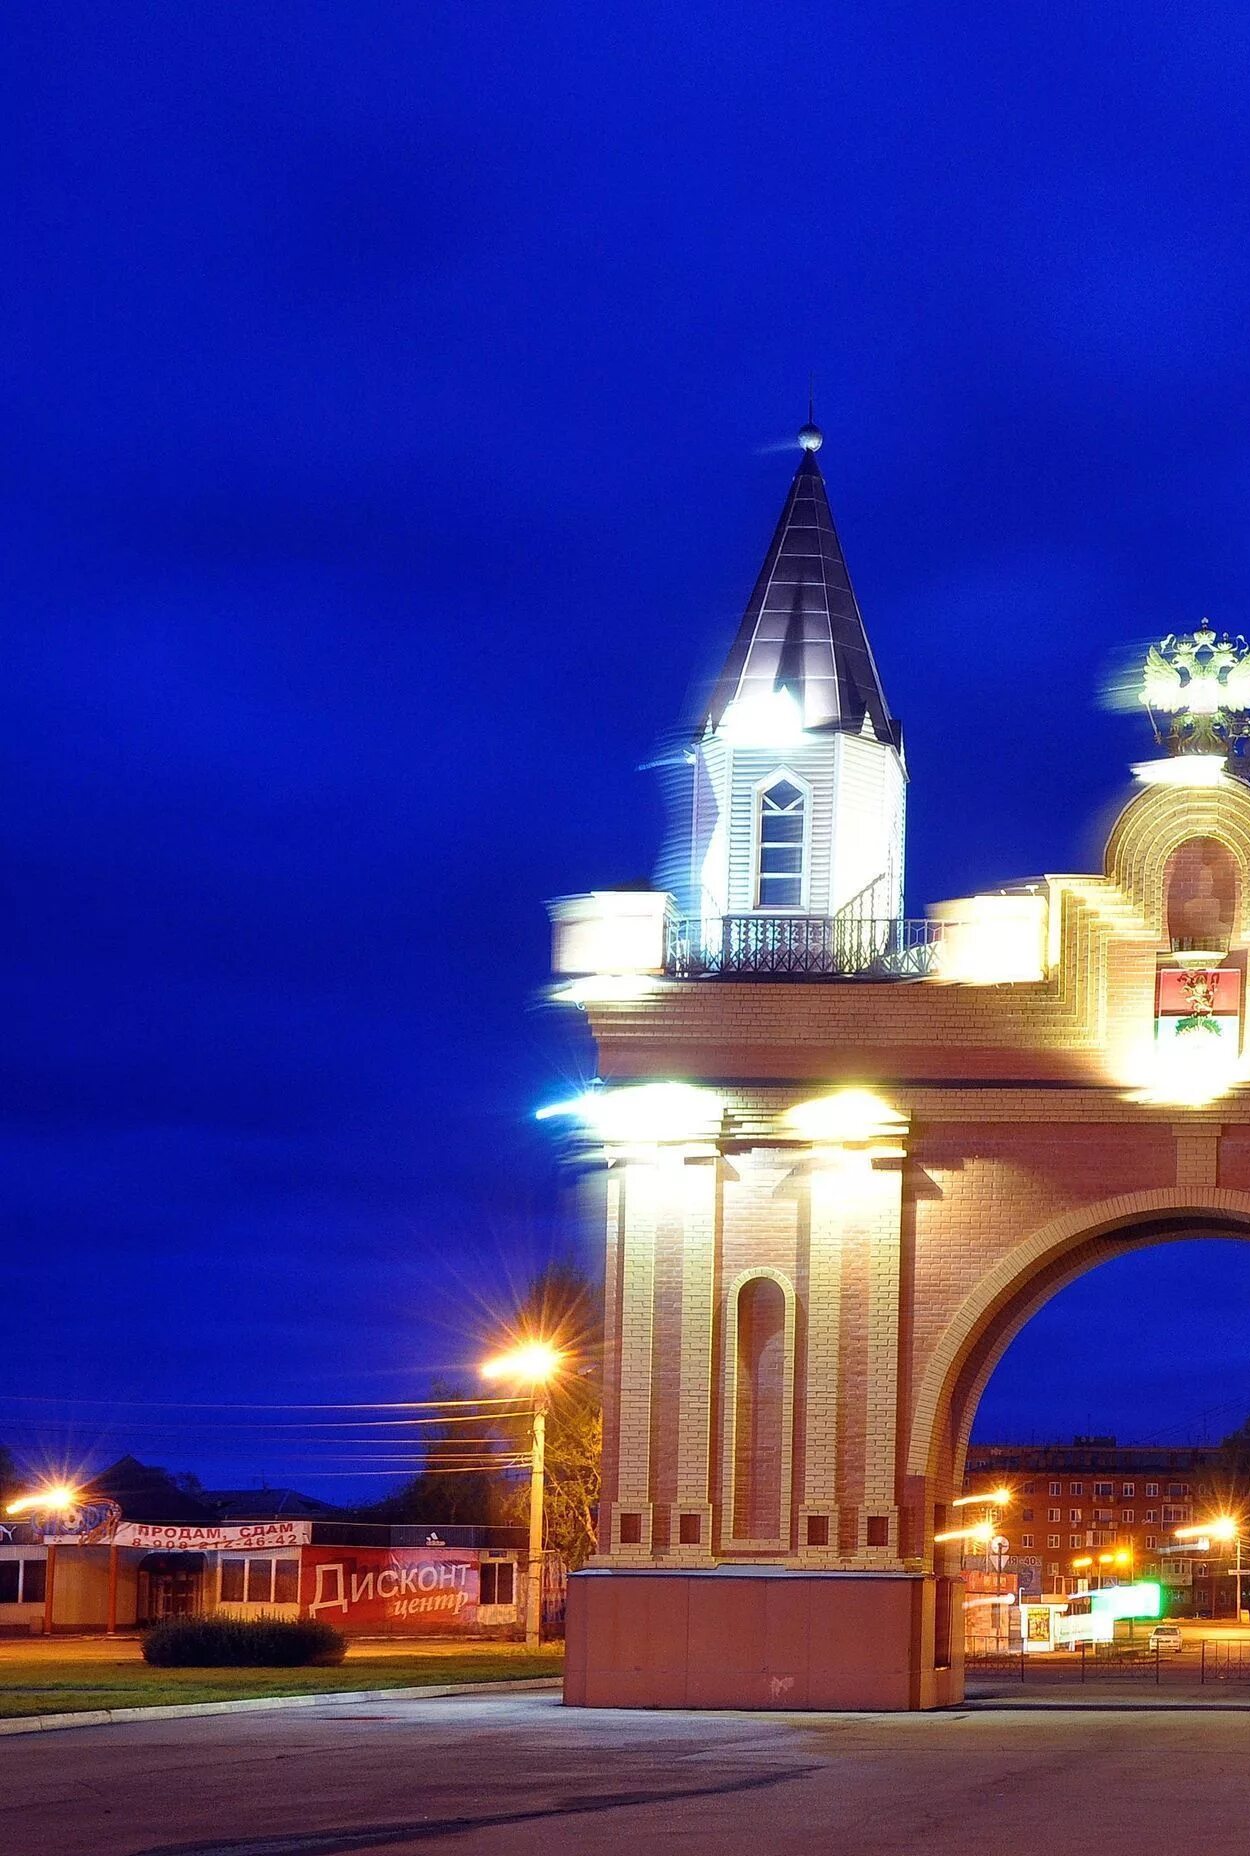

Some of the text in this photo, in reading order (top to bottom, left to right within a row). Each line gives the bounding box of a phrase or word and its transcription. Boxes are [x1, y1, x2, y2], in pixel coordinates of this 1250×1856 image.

[138, 1523, 294, 1541] ПРОДАМ, СДАМ
[394, 1590, 469, 1620] центр
